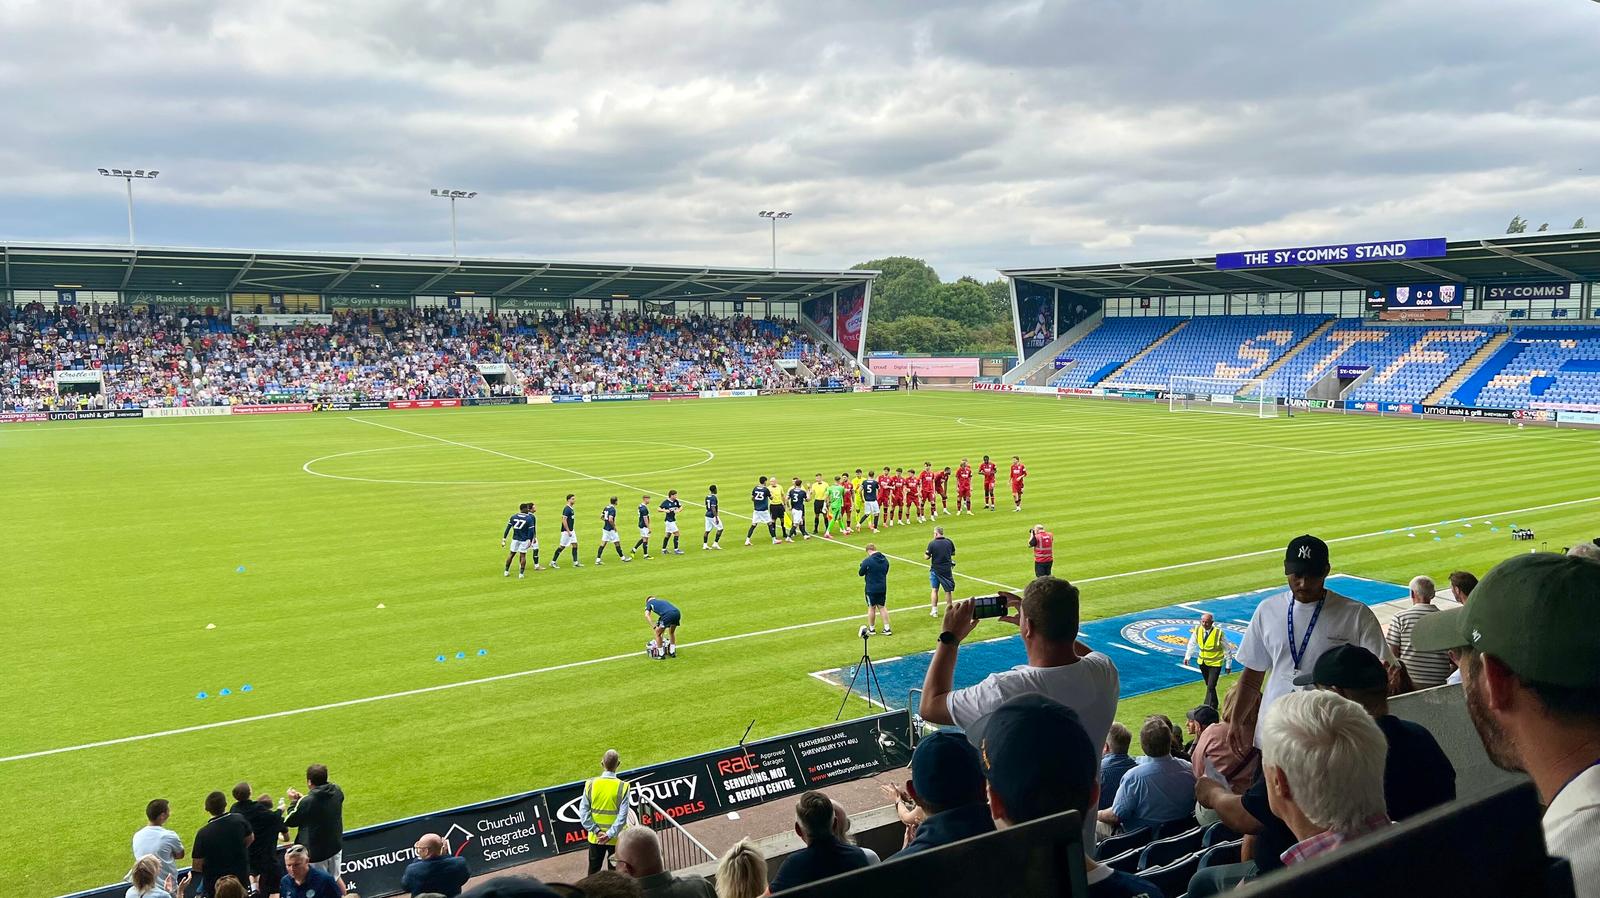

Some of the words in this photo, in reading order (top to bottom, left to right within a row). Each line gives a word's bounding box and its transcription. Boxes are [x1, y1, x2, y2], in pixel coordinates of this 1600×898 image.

[1244, 252, 1269, 265] THE
[1355, 243, 1407, 258] STAND
[155, 294, 188, 303] Racket
[189, 295, 220, 304] Sports
[350, 297, 371, 306] Gym
[523, 299, 561, 309] Swimming
[974, 383, 1013, 392] WILDES
[1354, 402, 1364, 410] sky
[1388, 403, 1399, 412] sky
[1424, 405, 1448, 416] umai
[50, 411, 78, 420] umai
[103, 411, 115, 419] grill
[866, 484, 873, 493] 5
[754, 491, 765, 501] 23
[792, 493, 799, 502] 3
[513, 518, 527, 530] 27
[760, 748, 786, 760] Approved
[801, 744, 837, 757] SHREWSBURY
[762, 757, 784, 767] Garages
[816, 761, 833, 771] 01743
[769, 766, 788, 780] MOT
[728, 794, 737, 804] &
[735, 785, 767, 802] REPAIR
[765, 778, 796, 794] CENTRE
[477, 811, 526, 832] Churchill
[480, 824, 537, 847] Integrated
[483, 843, 530, 861] Services
